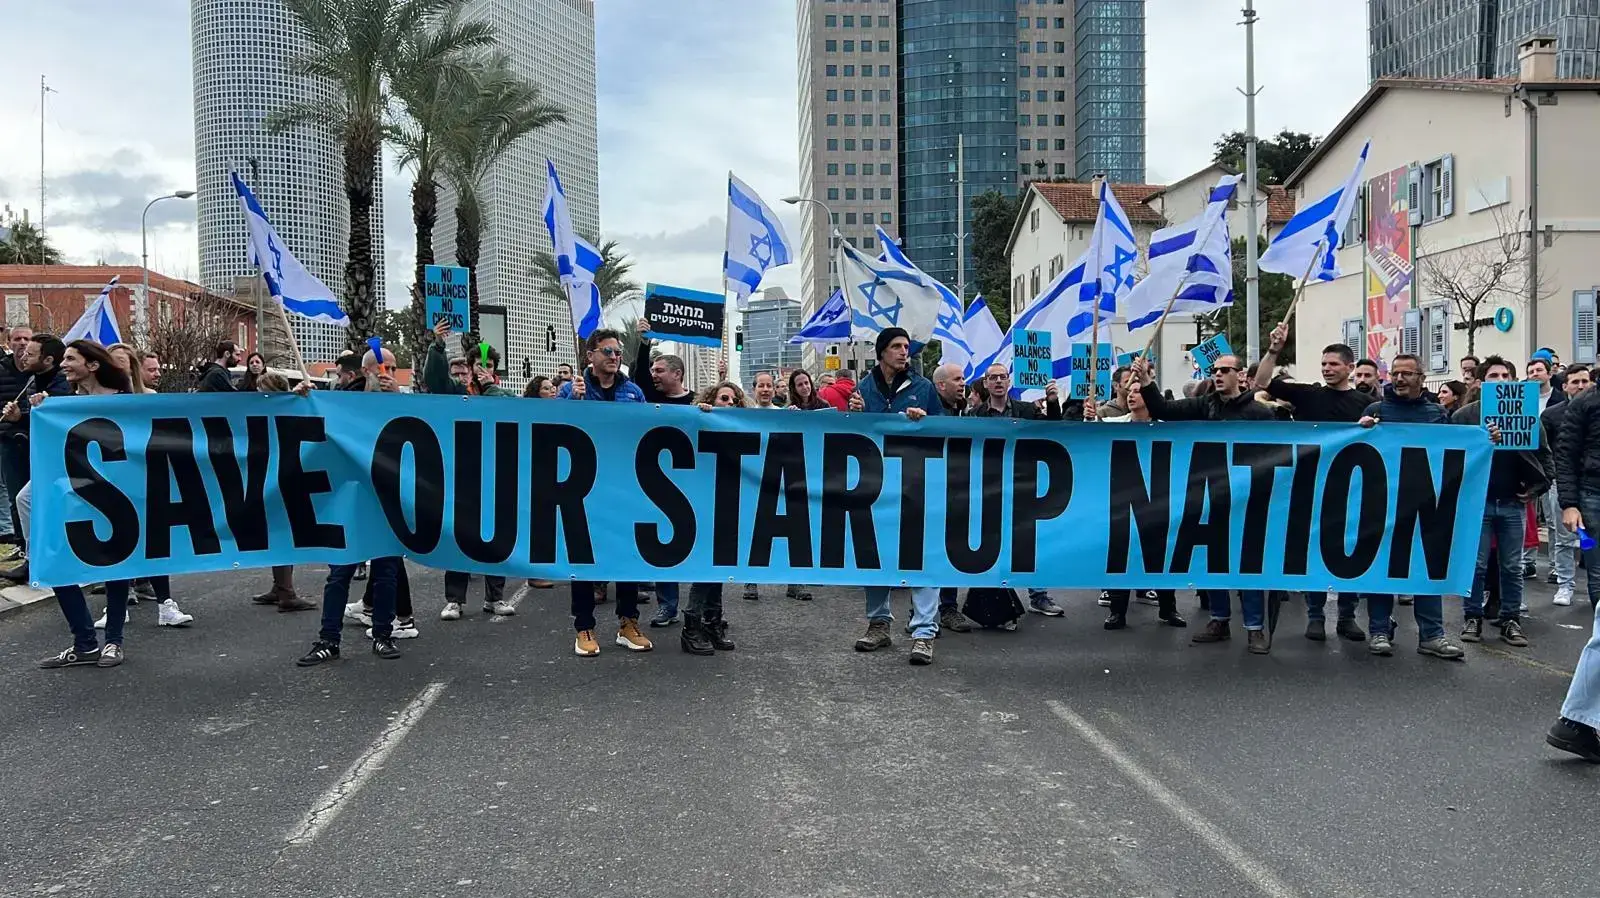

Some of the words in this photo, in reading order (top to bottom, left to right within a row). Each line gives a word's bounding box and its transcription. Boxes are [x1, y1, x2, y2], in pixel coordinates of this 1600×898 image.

[441, 268, 452, 283] NO
[427, 282, 467, 299] BALANCES
[442, 299, 453, 313] NO
[662, 302, 704, 319] מחאת
[650, 313, 715, 331] ההייטקיסטים
[1027, 332, 1038, 345] NO
[1014, 345, 1051, 360] BALANCES
[1200, 340, 1219, 356] SAVE
[1028, 359, 1039, 372] NO
[1072, 358, 1110, 371] BALACES
[1019, 372, 1048, 386] CHECKS
[1076, 384, 1105, 397] CHEKS
[1495, 384, 1525, 400] SAVE
[1497, 400, 1522, 415] OUR
[1484, 415, 1537, 431] STARTUP
[1494, 431, 1531, 447] ATION
[64, 415, 347, 567] SAVE
[371, 416, 596, 564] OUR
[634, 426, 1074, 574] STARTUP
[1105, 440, 1466, 581] NATION
